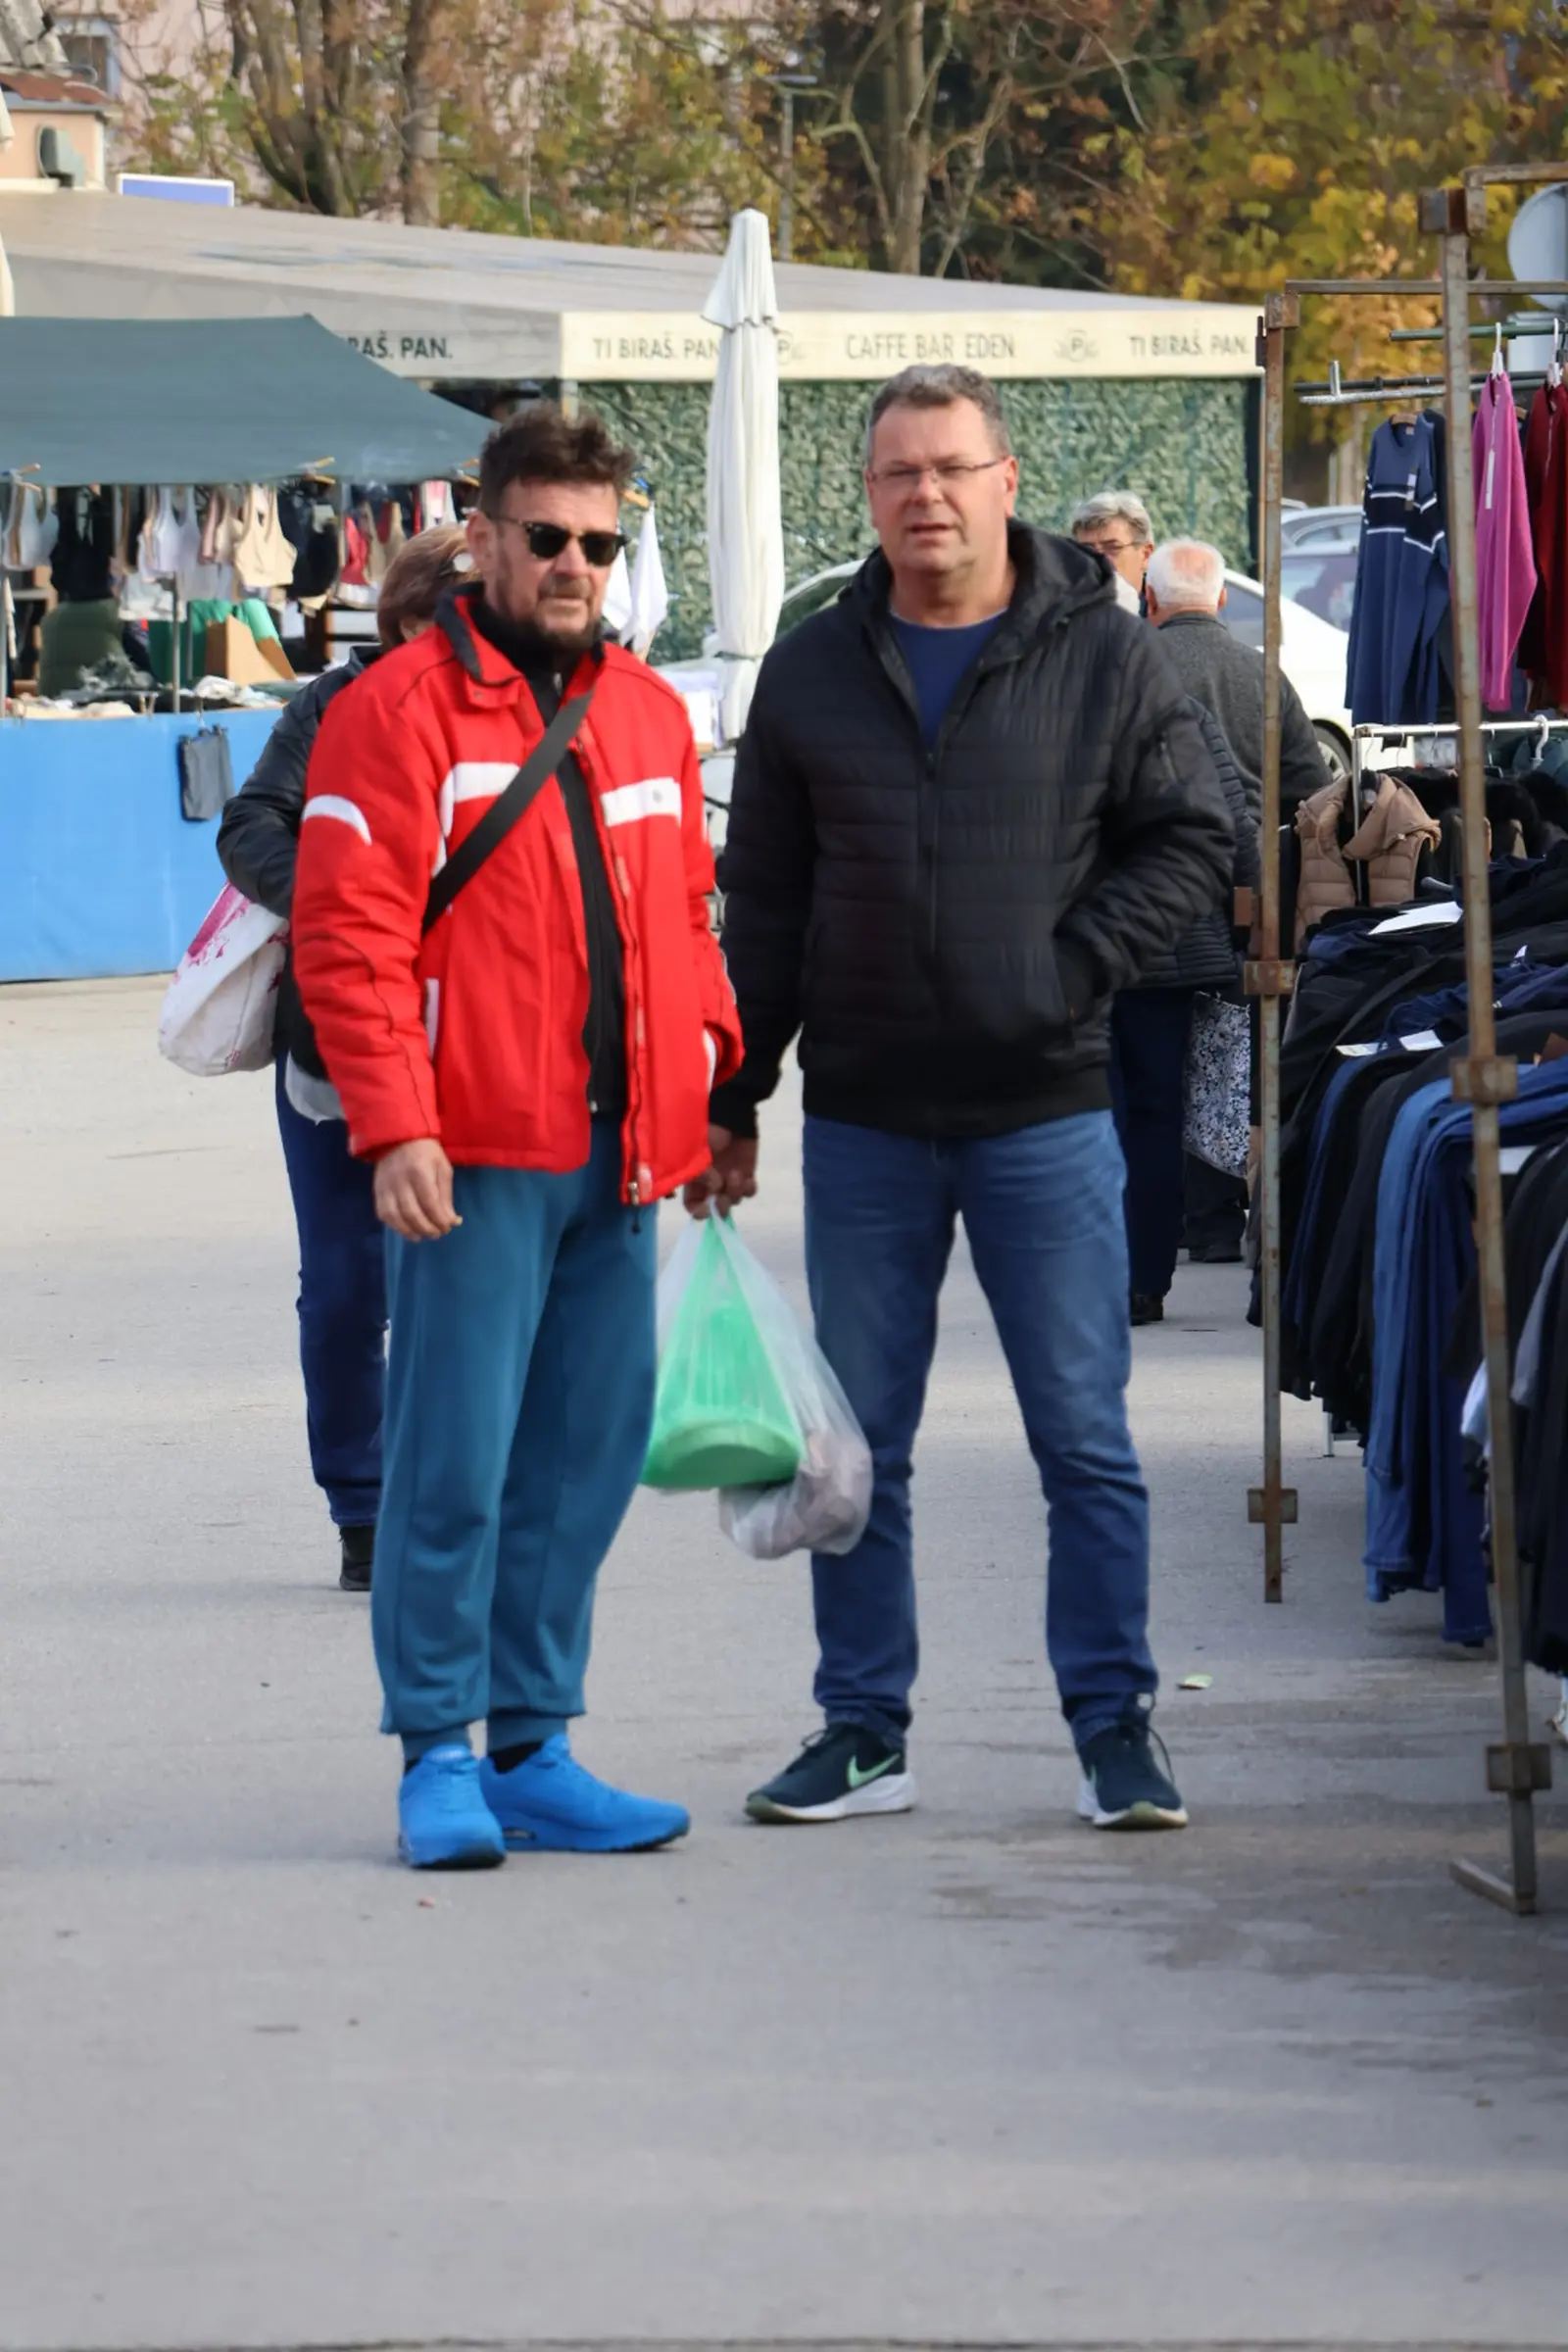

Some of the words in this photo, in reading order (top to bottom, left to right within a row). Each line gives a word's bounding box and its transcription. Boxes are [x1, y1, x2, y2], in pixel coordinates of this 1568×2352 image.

[401, 336, 454, 359] PAN.
[592, 337, 612, 359] TI
[846, 333, 908, 360] CAFFE
[915, 333, 955, 360] BAR
[965, 333, 1016, 360] EDEN
[1129, 335, 1146, 357] TI
